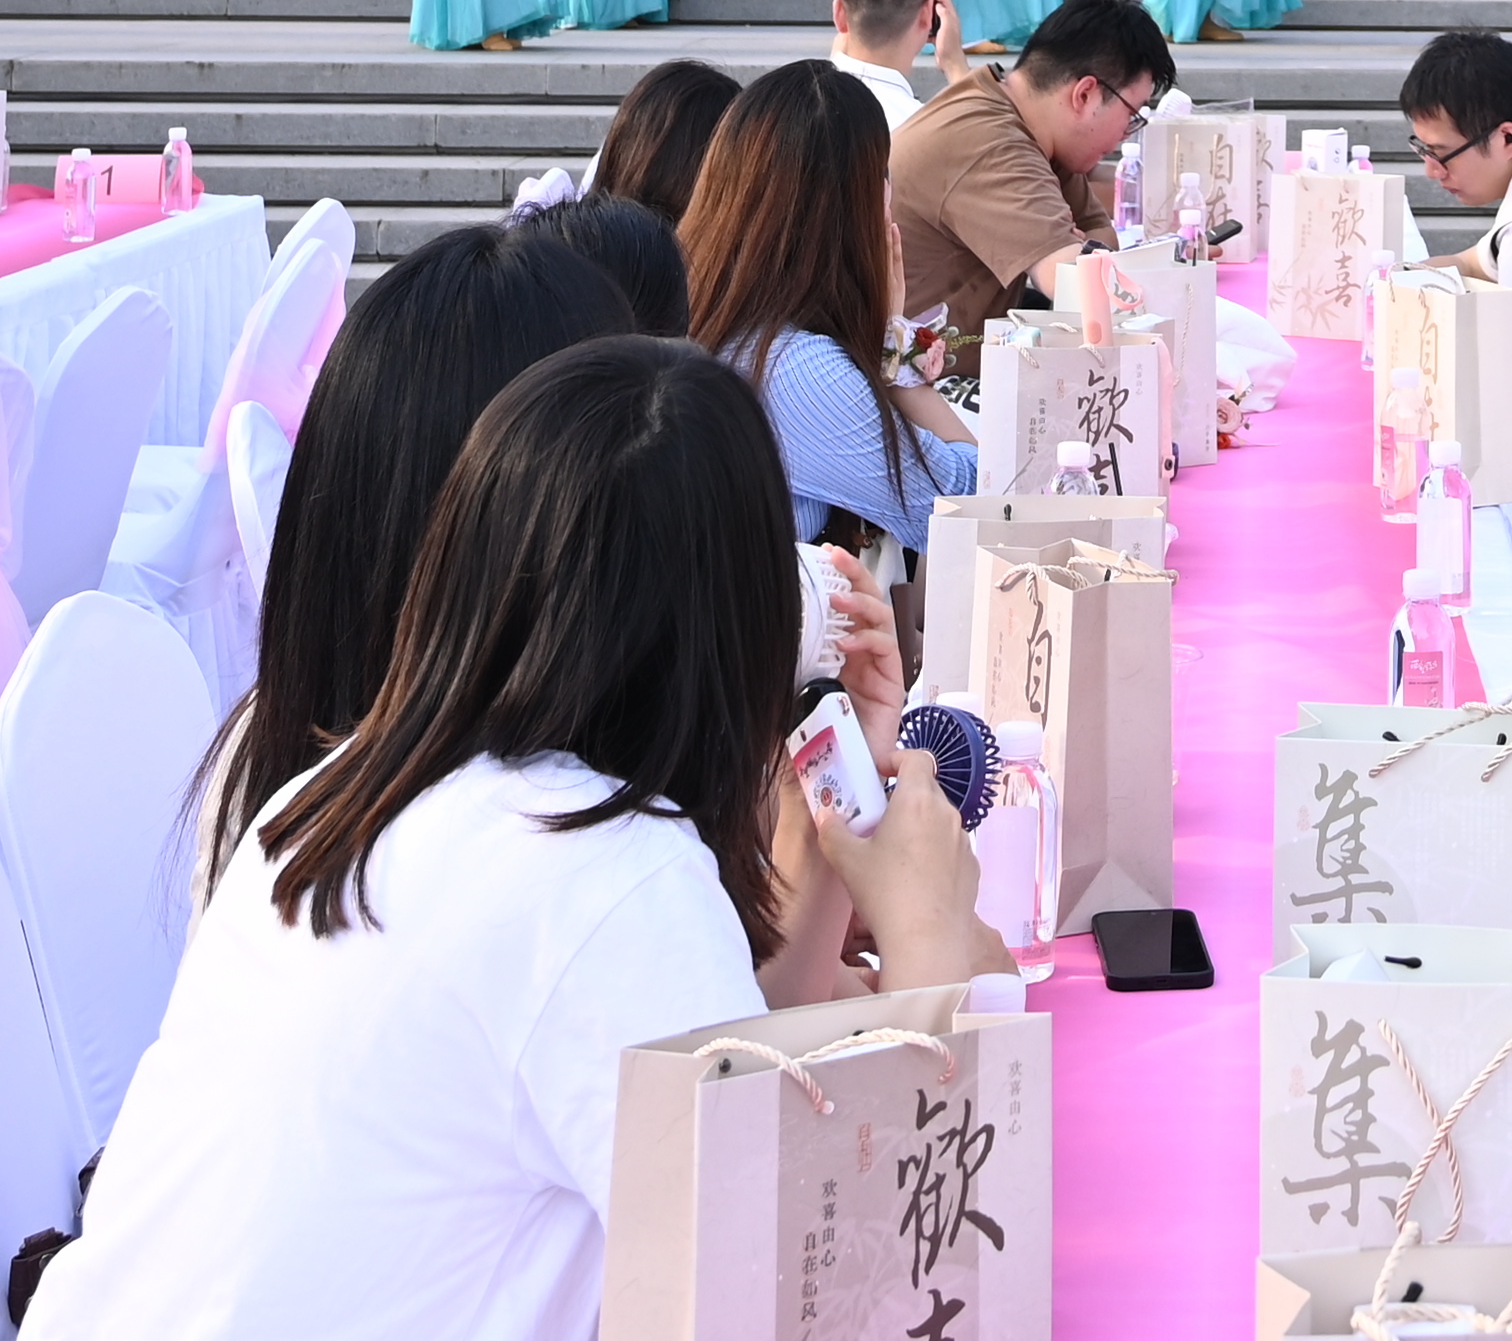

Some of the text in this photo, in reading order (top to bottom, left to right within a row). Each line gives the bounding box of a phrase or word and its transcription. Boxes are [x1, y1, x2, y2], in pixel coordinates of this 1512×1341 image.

[101, 165, 114, 196] 1
[1008, 1060, 1023, 1136] 欢喜由心
[1282, 1010, 1413, 1228] 集
[821, 1178, 838, 1267] 欢喜由心
[801, 1232, 819, 1322] 自在如风
